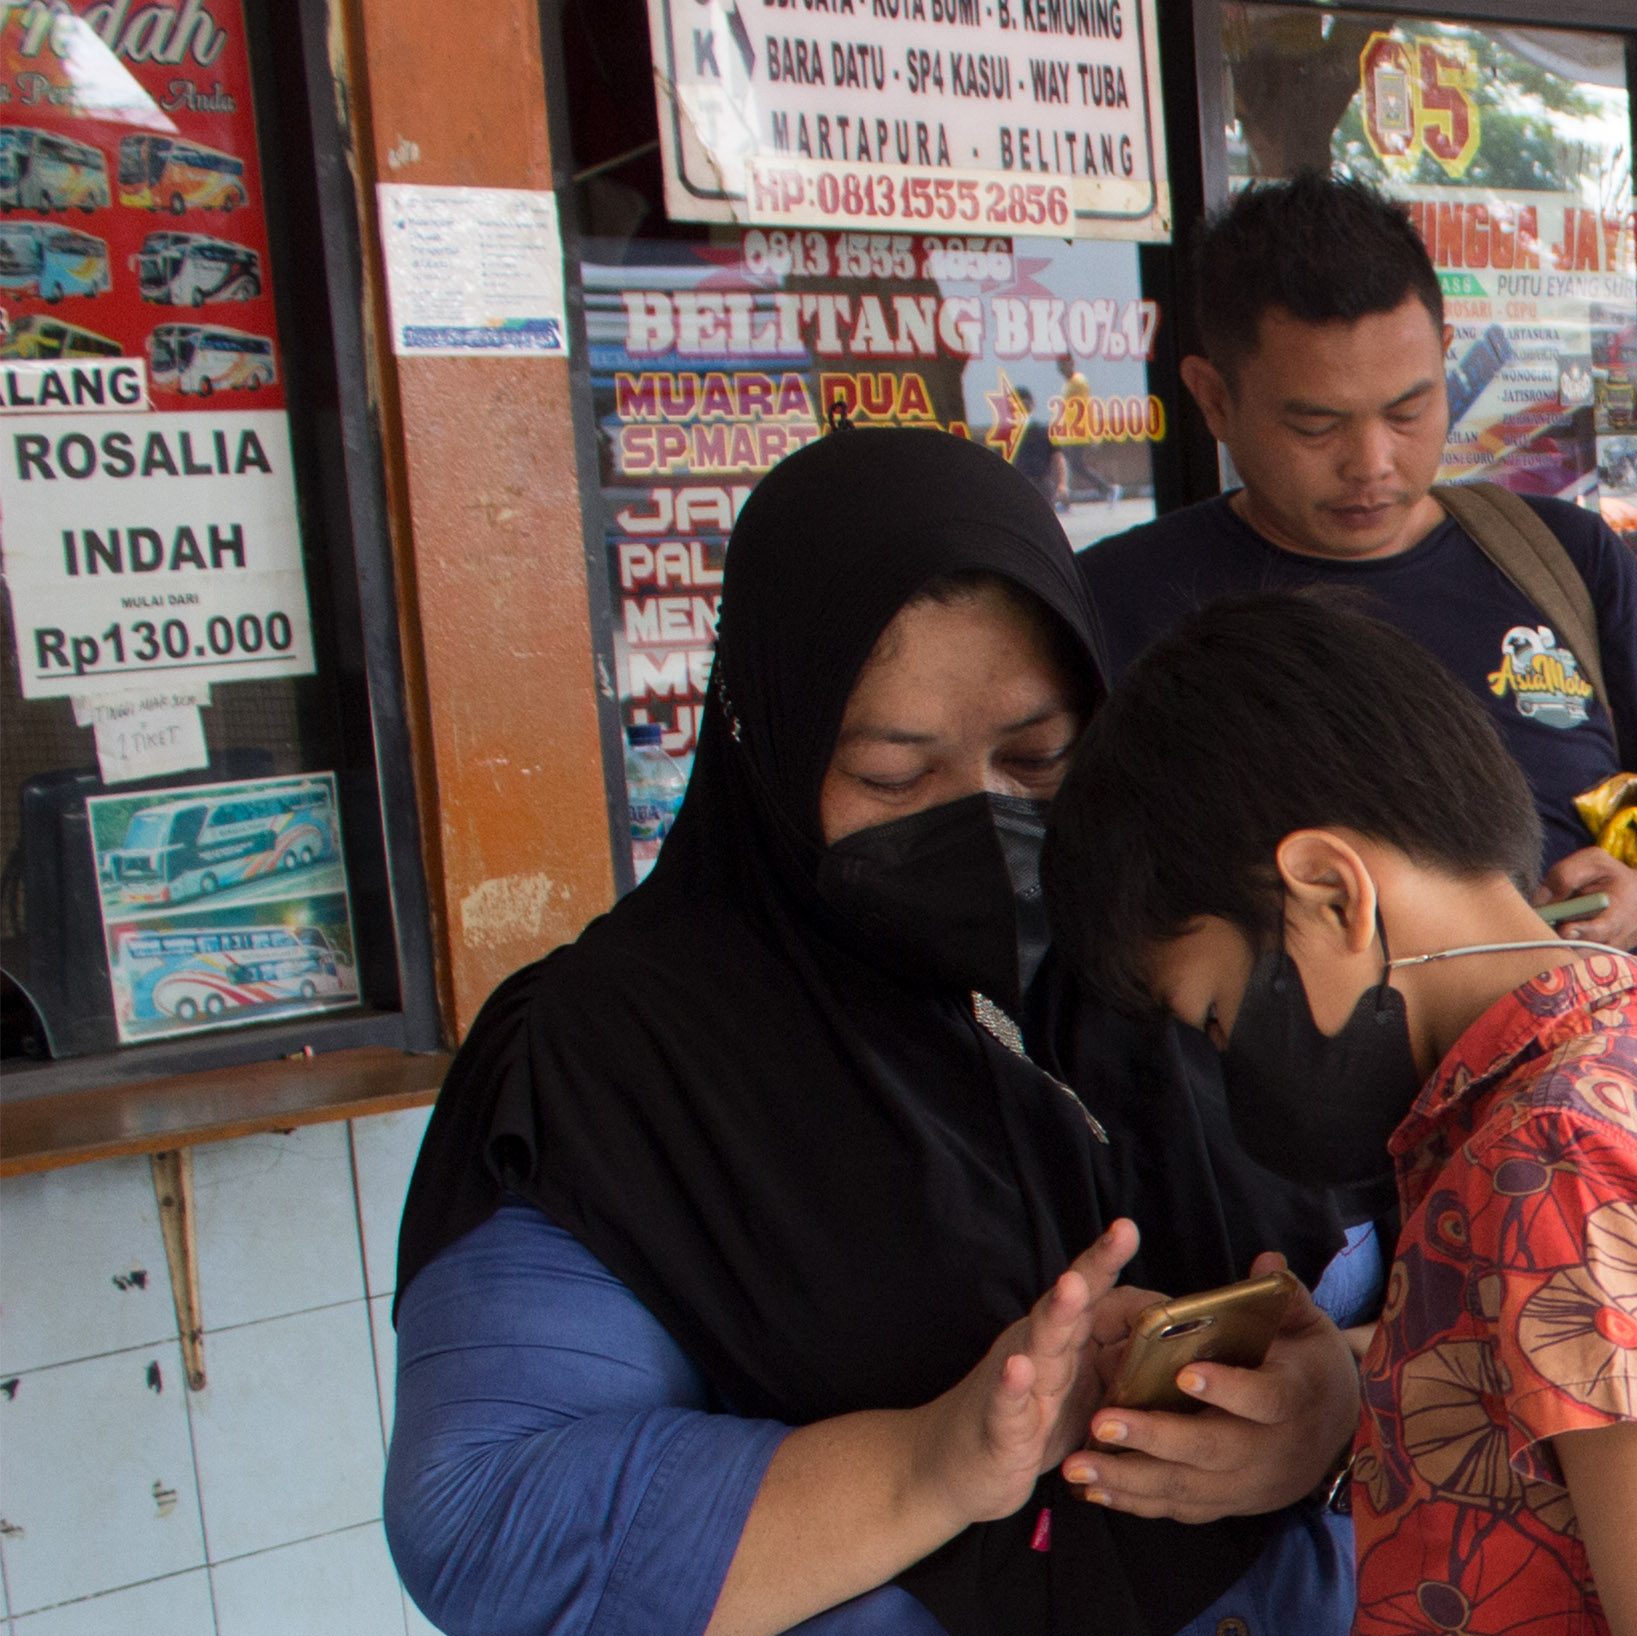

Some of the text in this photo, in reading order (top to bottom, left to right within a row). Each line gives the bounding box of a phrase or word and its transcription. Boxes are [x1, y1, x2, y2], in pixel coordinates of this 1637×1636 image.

[766, 36, 1130, 110] BARA DATU SP4 KASUI WAY TUBA
[1360, 32, 1480, 178] 05
[771, 110, 1135, 178] MARTAPURA BELITANG
[835, 234, 916, 279] 1555
[1497, 274, 1542, 297] PUTU
[1546, 275, 1600, 299] EYANG
[622, 290, 985, 360] BELITANG
[614, 371, 934, 421] MUARA DUA
[1047, 395, 1166, 442] 220.000
[14, 429, 272, 481] ROSALIA
[62, 523, 246, 577] INDAH
[121, 592, 199, 609] MULAI DARI
[34, 611, 293, 675] Rp130.000
[131, 725, 180, 752] TIKET
